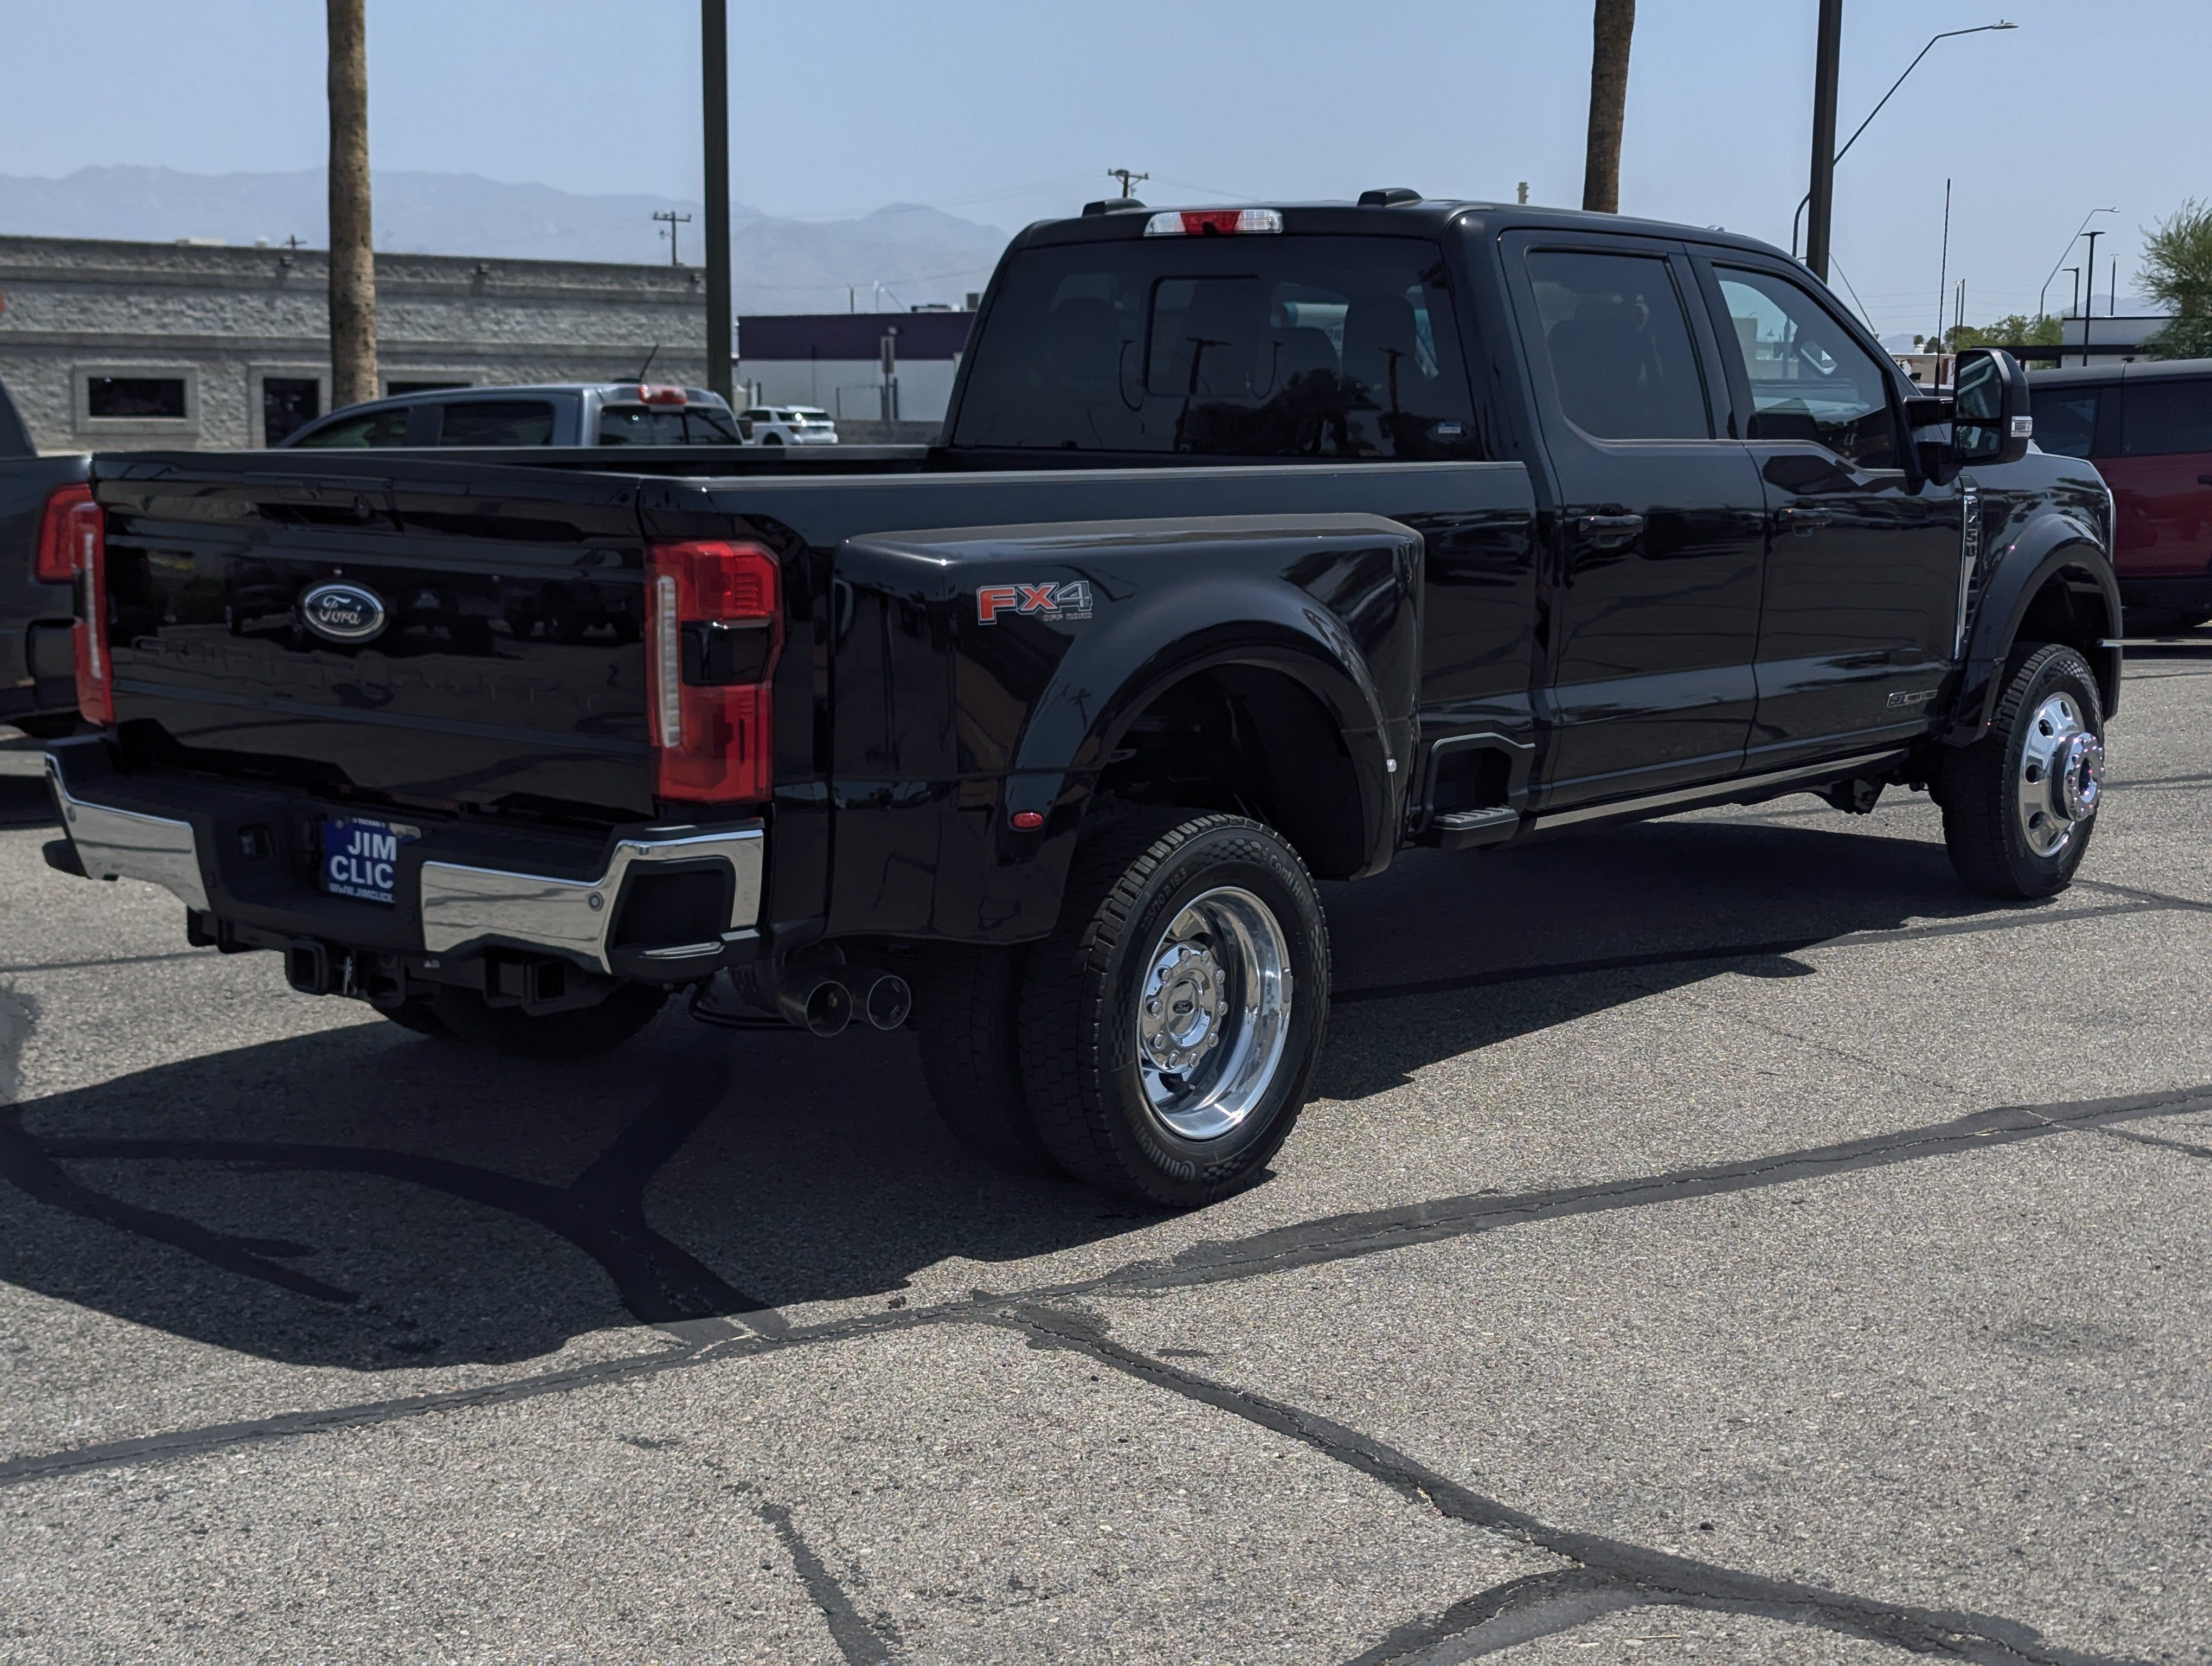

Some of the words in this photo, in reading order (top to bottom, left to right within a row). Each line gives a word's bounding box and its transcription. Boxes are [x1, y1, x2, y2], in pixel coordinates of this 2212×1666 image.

[319, 595, 362, 625] Ford
[976, 581, 1092, 625] FX4
[348, 831, 397, 861] JIM
